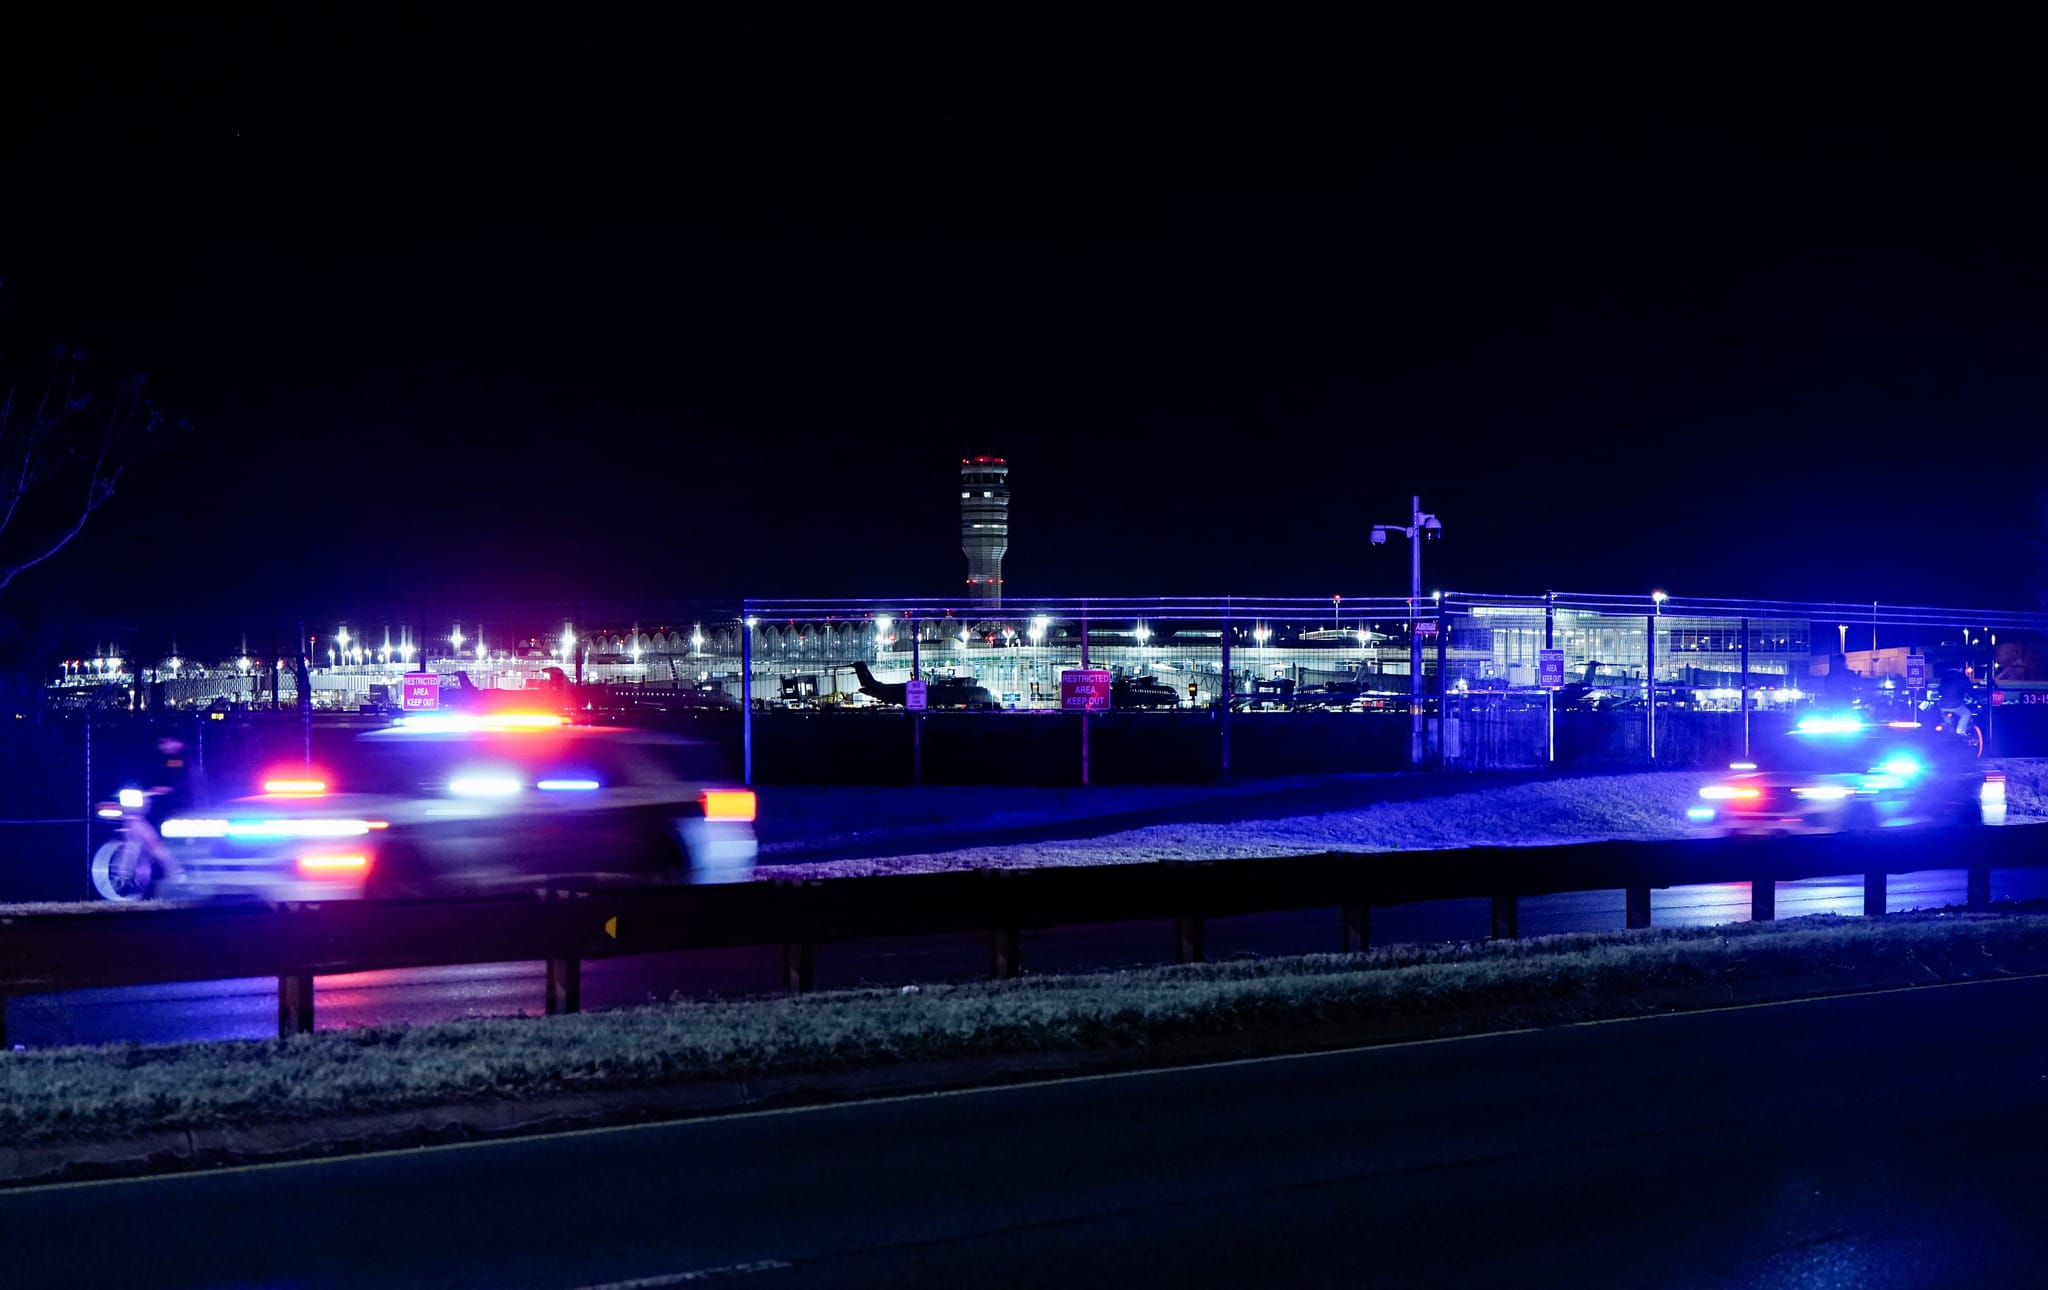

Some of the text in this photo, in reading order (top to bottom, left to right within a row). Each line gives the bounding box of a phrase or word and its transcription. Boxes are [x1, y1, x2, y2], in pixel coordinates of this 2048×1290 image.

[404, 677, 438, 685] RESTRICTED
[1063, 674, 1109, 682] RESTRICTED
[413, 687, 429, 696] AREA
[1075, 685, 1096, 694] AREA
[407, 698, 434, 706] KEEP OUT
[1066, 697, 1105, 705] KEEP OUT
